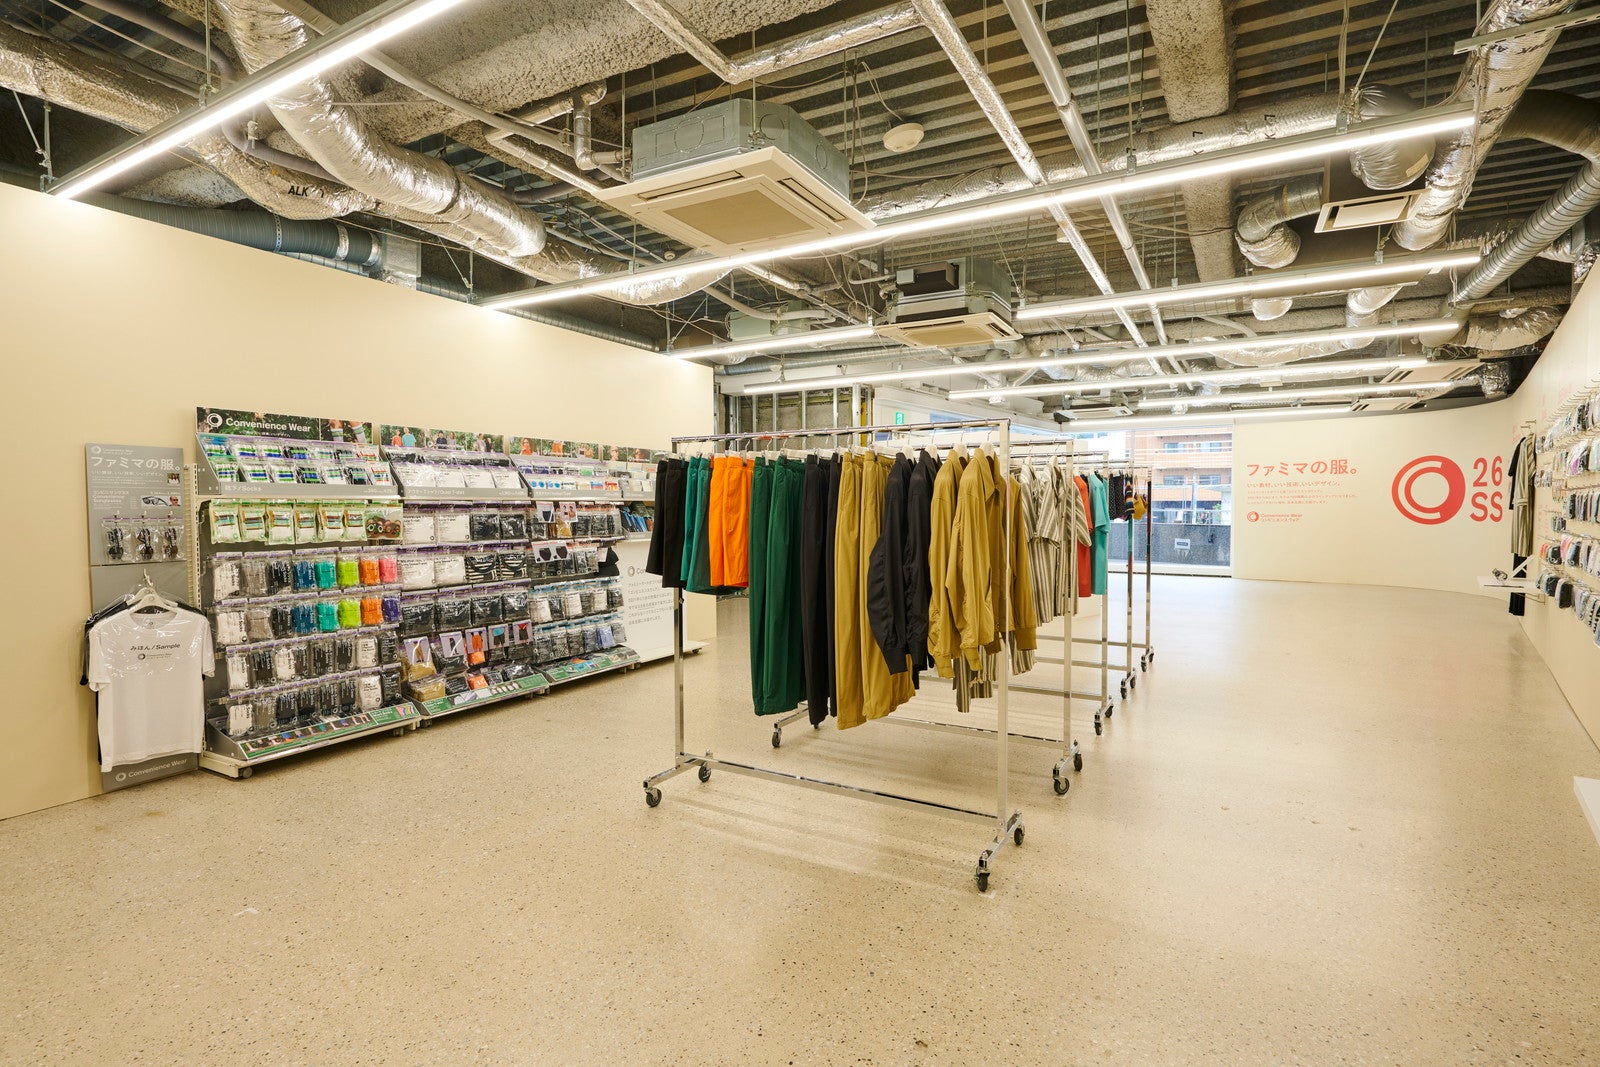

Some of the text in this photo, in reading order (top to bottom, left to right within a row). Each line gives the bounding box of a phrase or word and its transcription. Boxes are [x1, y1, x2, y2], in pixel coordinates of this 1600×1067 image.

[225, 418, 311, 433] Convenience Wear
[91, 456, 180, 471] ファミマの服。
[1246, 458, 1357, 476] ファミマの服。
[1472, 455, 1503, 487] 26
[1469, 491, 1504, 523] SS
[128, 758, 188, 778] Convenience Wear
